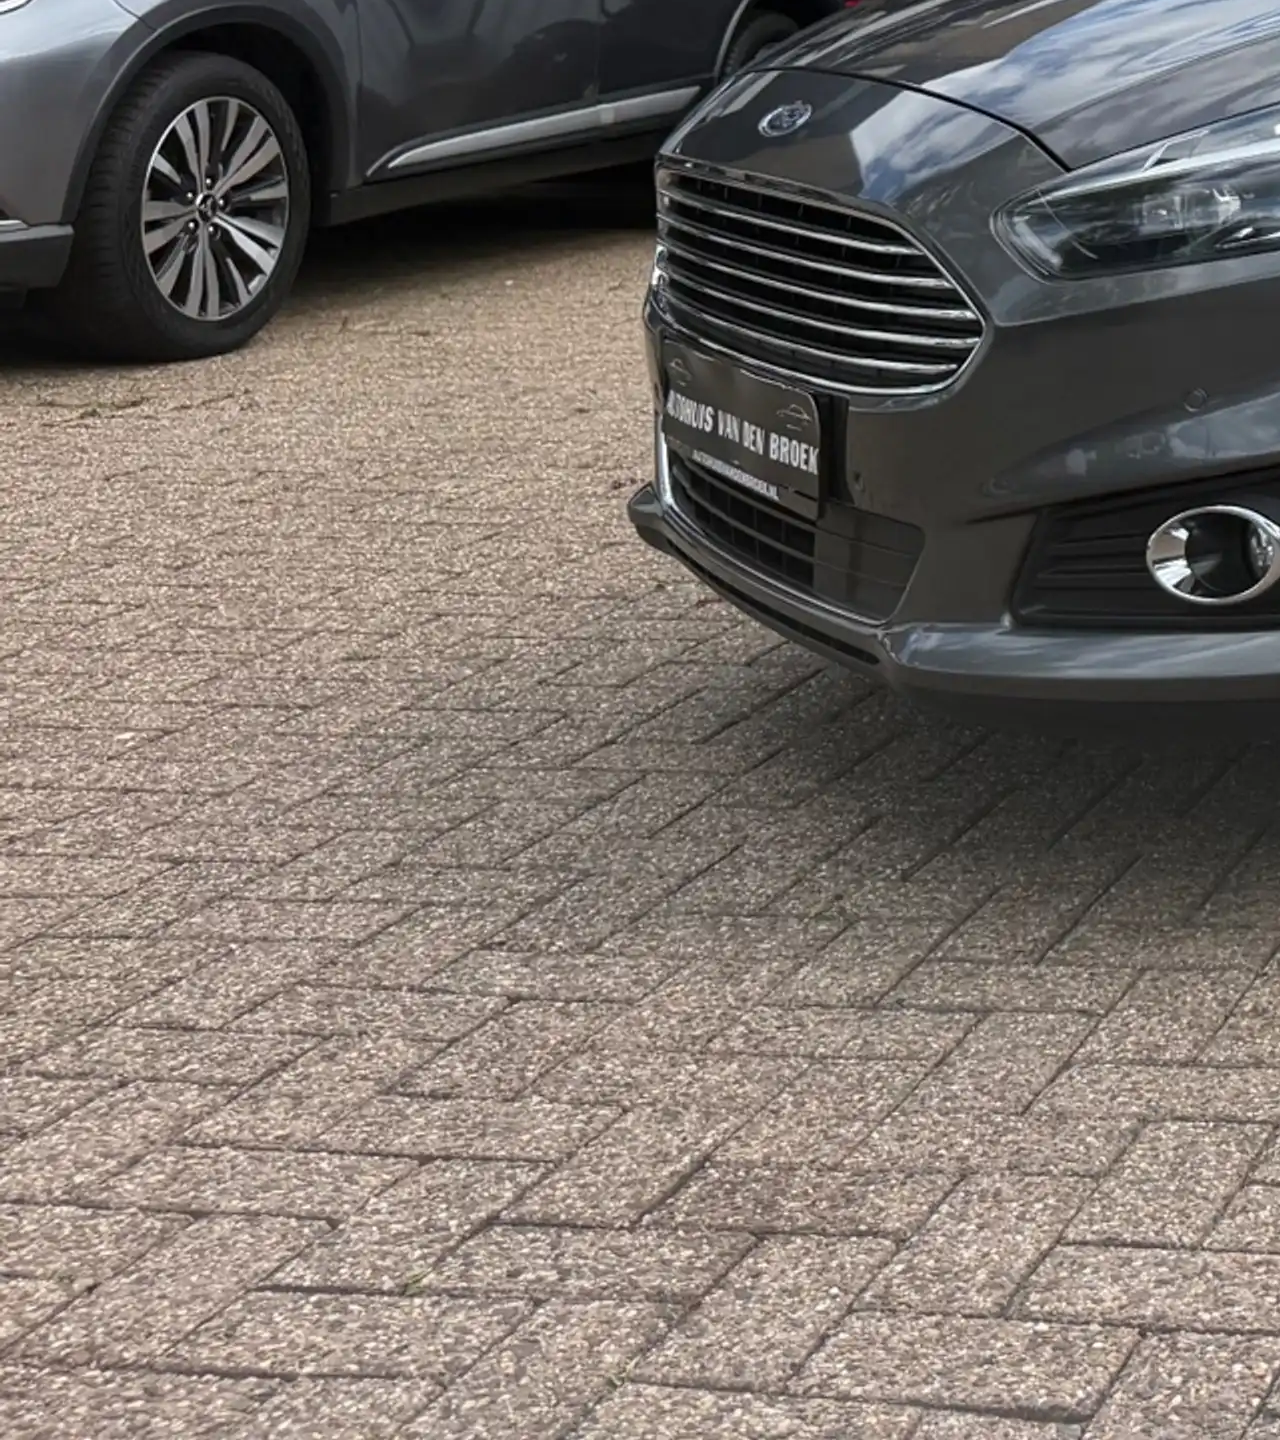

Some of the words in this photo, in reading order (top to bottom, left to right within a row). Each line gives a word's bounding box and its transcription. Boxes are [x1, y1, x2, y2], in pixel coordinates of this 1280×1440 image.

[717, 409, 740, 443] VAN
[742, 420, 765, 456] DEN
[769, 432, 819, 475] BROEK
